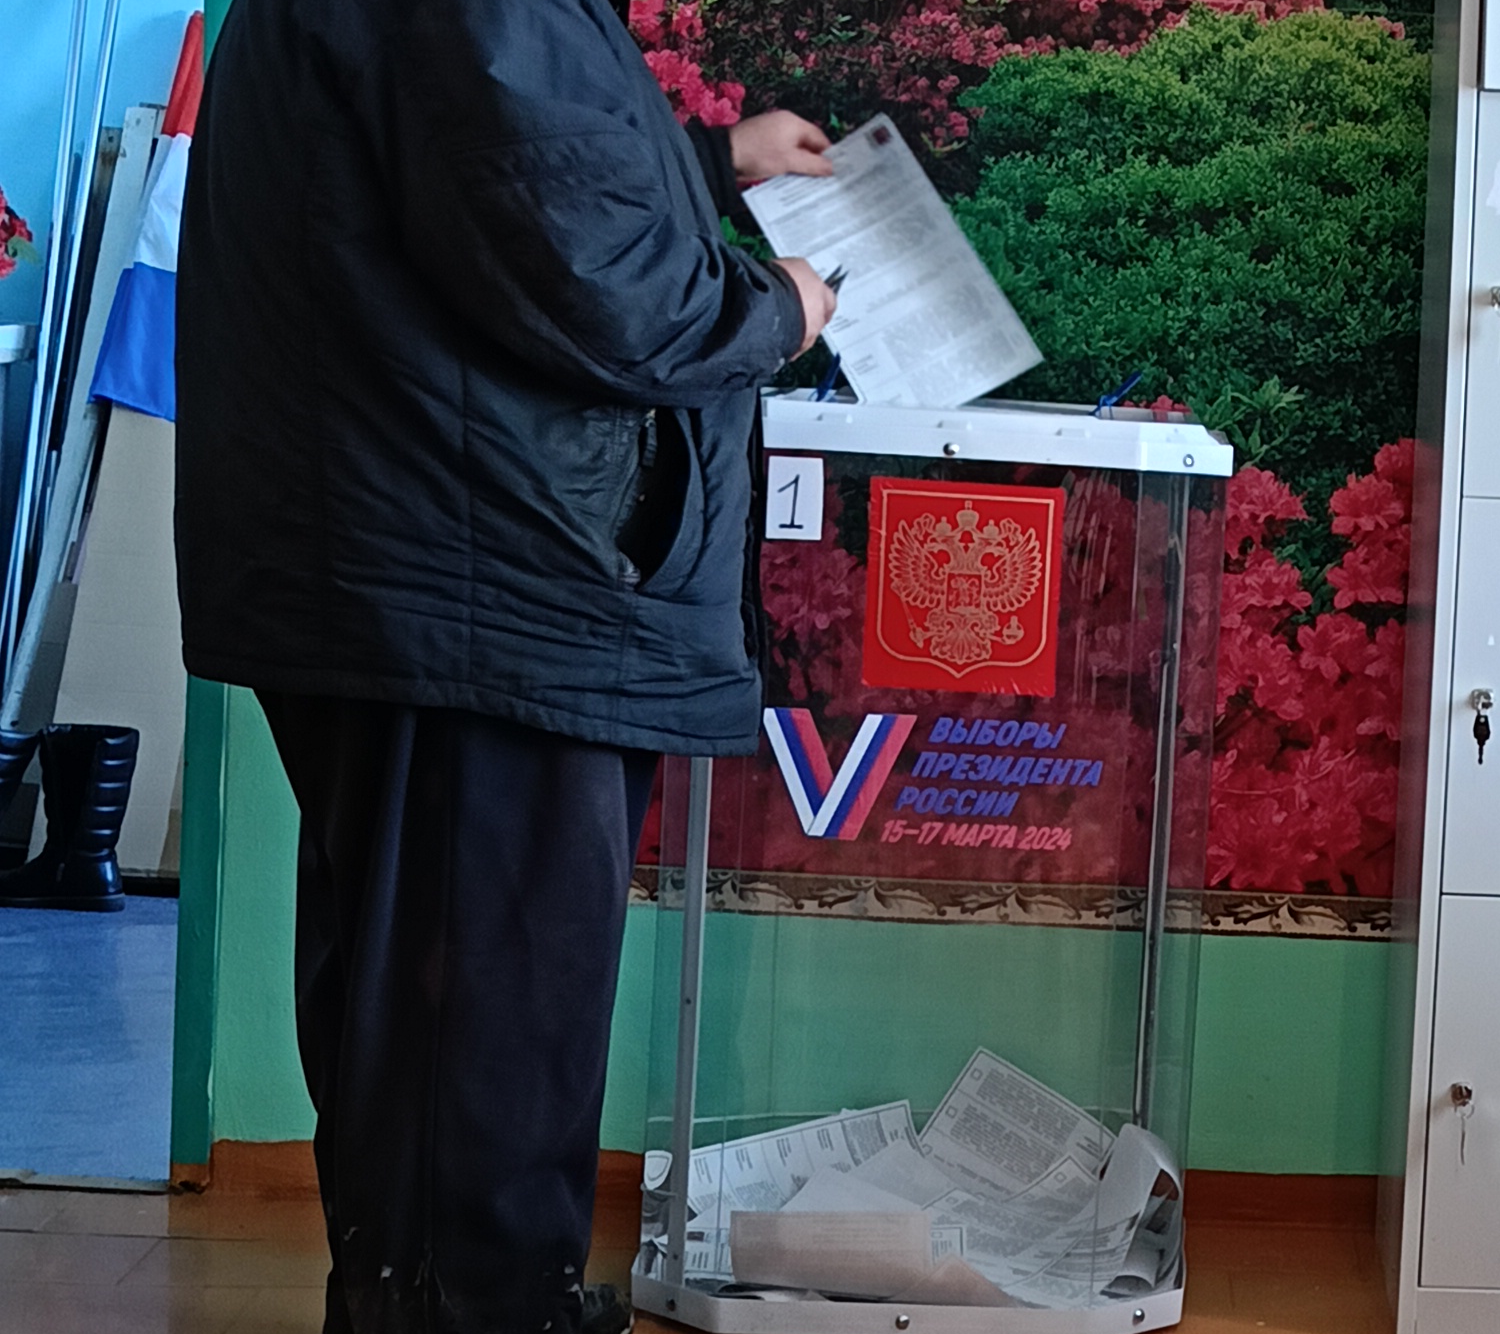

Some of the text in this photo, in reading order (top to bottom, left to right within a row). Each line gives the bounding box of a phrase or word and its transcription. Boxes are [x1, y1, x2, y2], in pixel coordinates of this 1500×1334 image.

[777, 474, 804, 530] 1
[930, 717, 1067, 749] ВЫБОРЫ
[911, 751, 1103, 787] ПРЕЗИДЕНТА
[894, 786, 1020, 817] РОССИИ
[880, 820, 1072, 851] 15–17 МАРТА 2024
